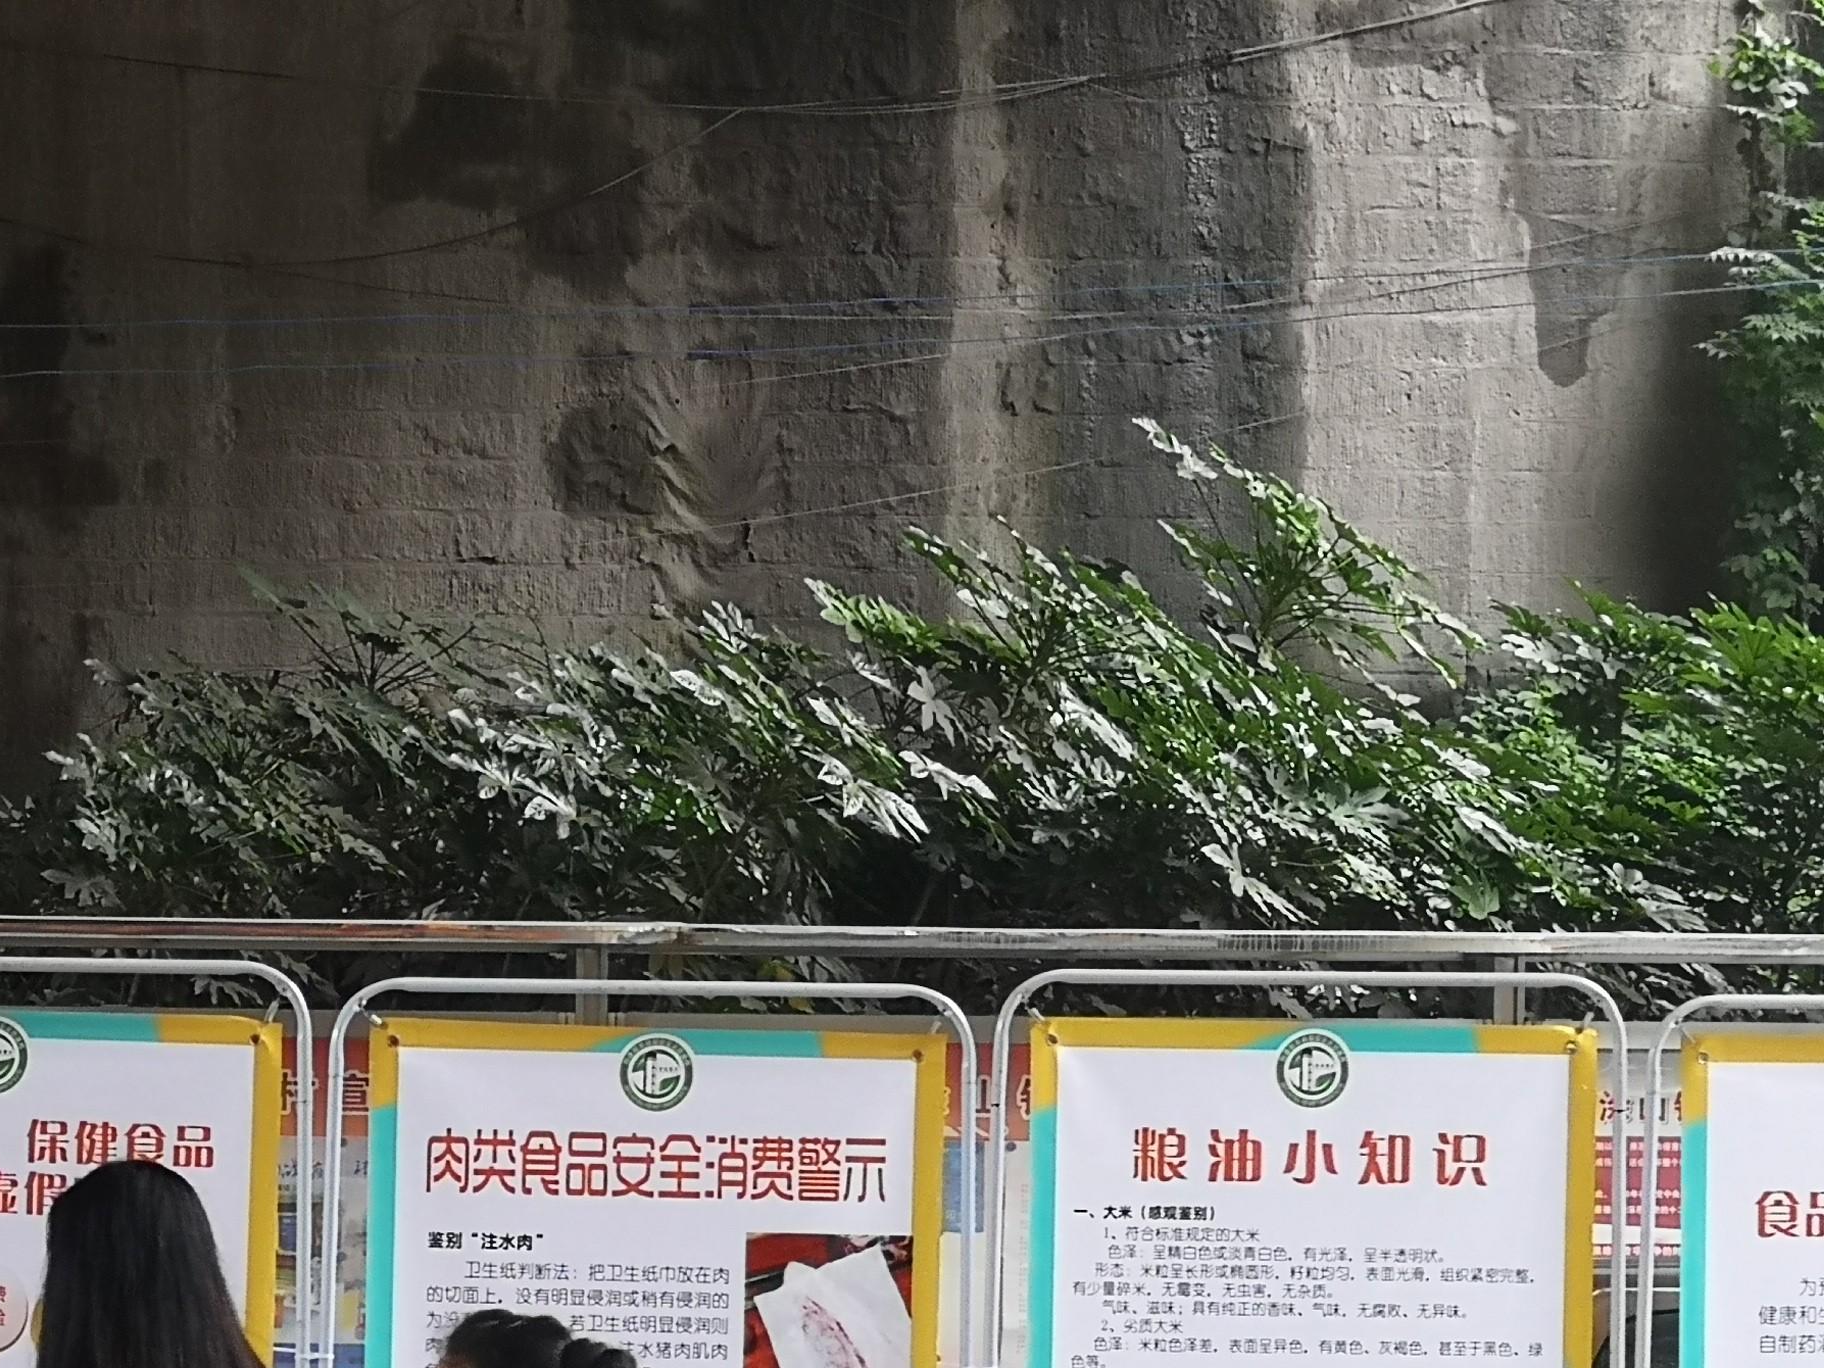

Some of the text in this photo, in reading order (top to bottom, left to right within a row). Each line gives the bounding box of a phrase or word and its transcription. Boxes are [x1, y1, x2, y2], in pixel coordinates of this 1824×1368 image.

[425, 1127, 887, 1203] 肉类食品安全消费警示
[1131, 1125, 1489, 1187] 粮油小知识
